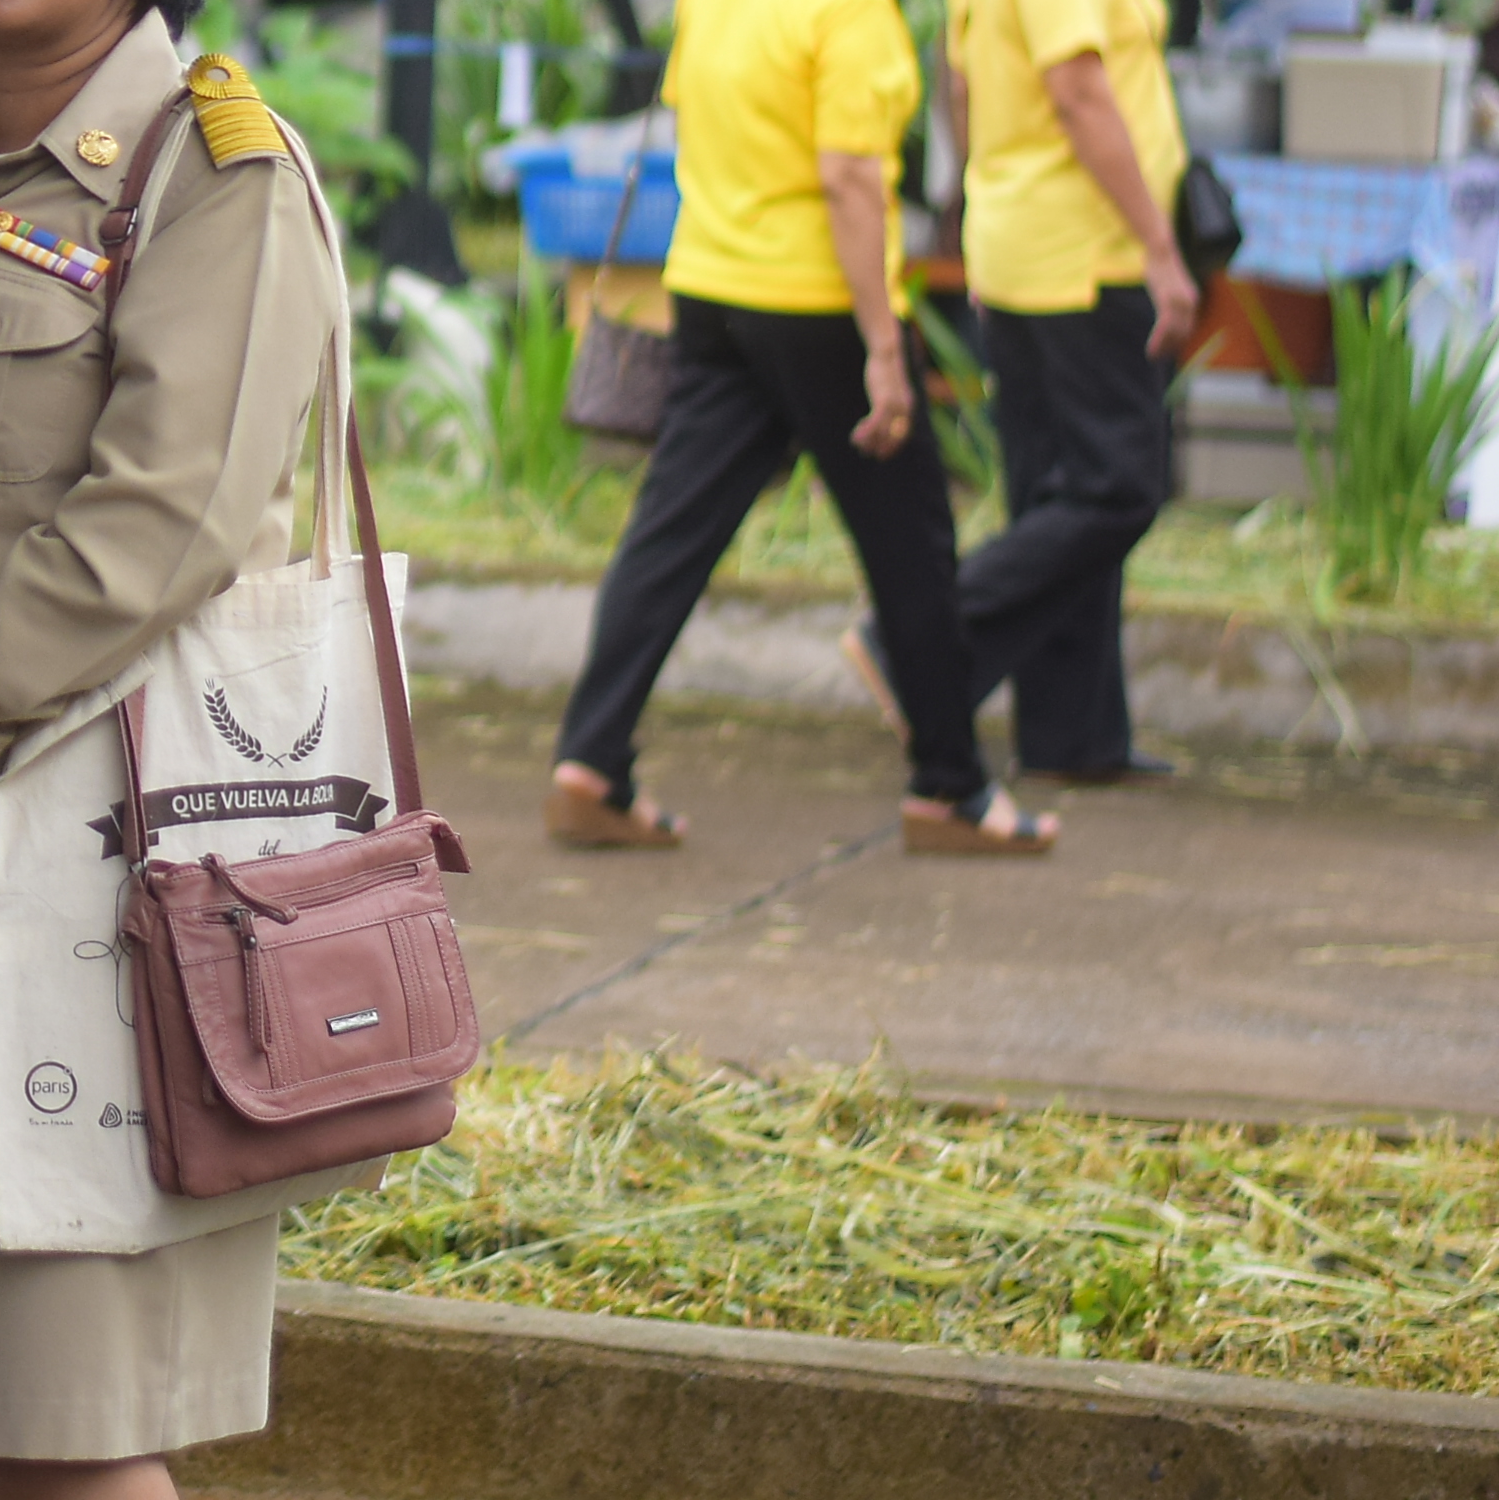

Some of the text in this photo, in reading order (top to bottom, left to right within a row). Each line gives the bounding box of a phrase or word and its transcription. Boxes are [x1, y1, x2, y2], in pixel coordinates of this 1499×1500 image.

[172, 792, 217, 818] QUE
[220, 789, 290, 810] VUELVA
[293, 789, 310, 807] LA
[257, 839, 282, 857] del
[31, 1080, 71, 1096] paris
